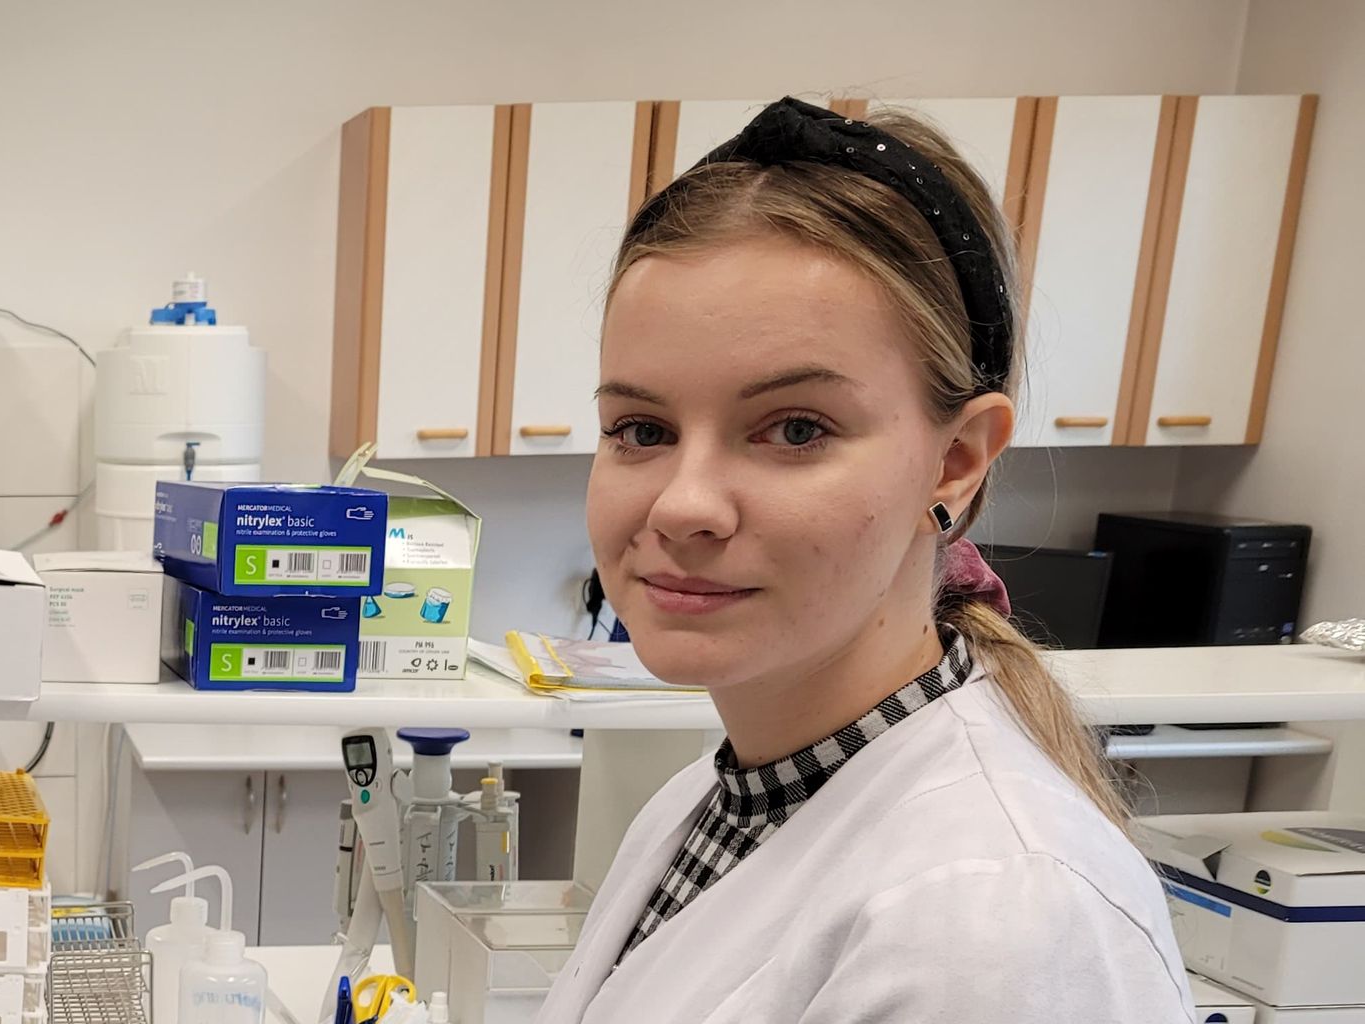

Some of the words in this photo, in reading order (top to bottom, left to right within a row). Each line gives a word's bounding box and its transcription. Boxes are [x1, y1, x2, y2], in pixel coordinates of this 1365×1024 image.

[287, 515, 315, 527] basic
[291, 529, 319, 537] protective
[319, 530, 337, 538] gloves
[245, 555, 257, 575] S
[263, 615, 291, 627] basic
[221, 653, 232, 672] S
